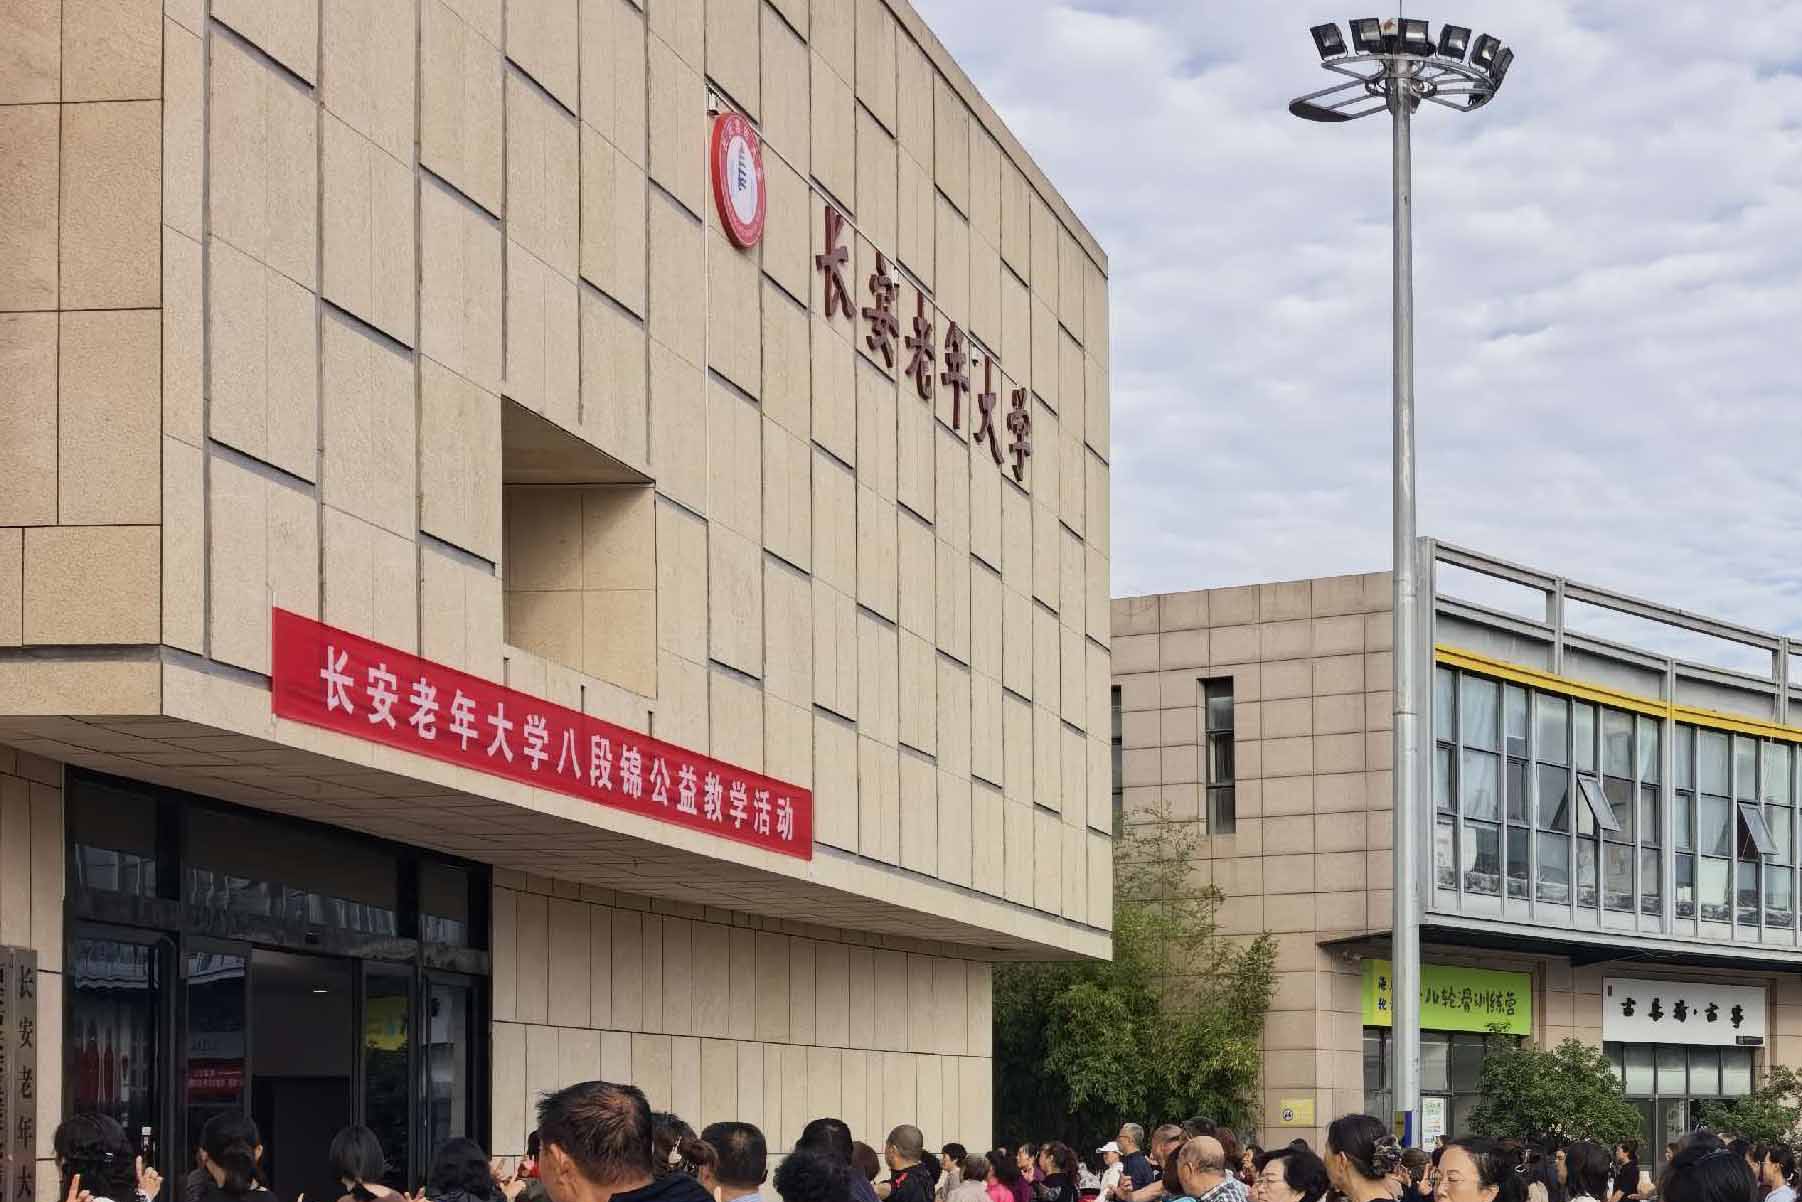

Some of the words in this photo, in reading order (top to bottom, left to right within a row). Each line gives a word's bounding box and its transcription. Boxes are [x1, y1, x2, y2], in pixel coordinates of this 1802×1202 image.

[319, 645, 794, 842] 长安老年大学八段锦公益教学活动
[1419, 985, 1517, 1016] 儿轮滑训练营
